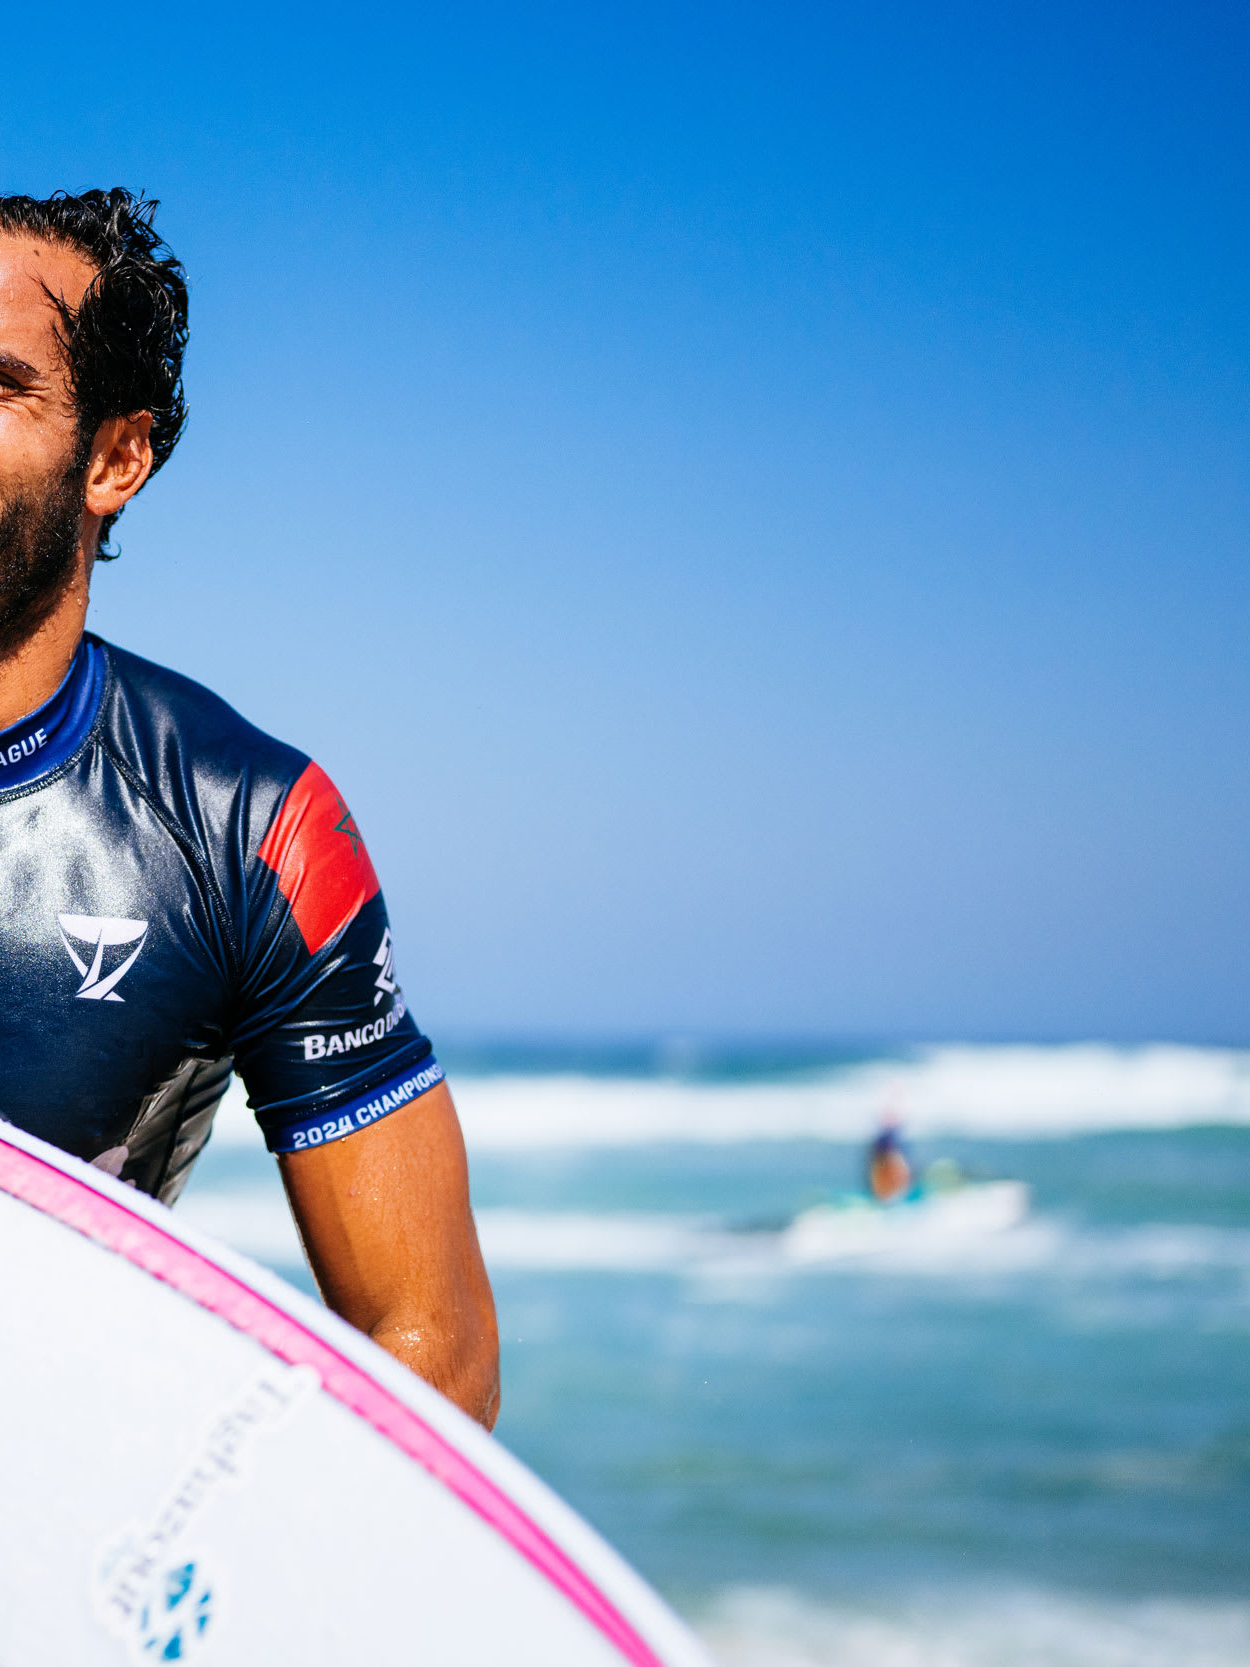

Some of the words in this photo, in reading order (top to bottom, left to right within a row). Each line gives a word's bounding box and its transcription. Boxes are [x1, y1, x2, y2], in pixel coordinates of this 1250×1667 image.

[303, 1017, 385, 1061] BANCO
[292, 1115, 355, 1149] 2024
[356, 1064, 443, 1125] CHAMPIONS
